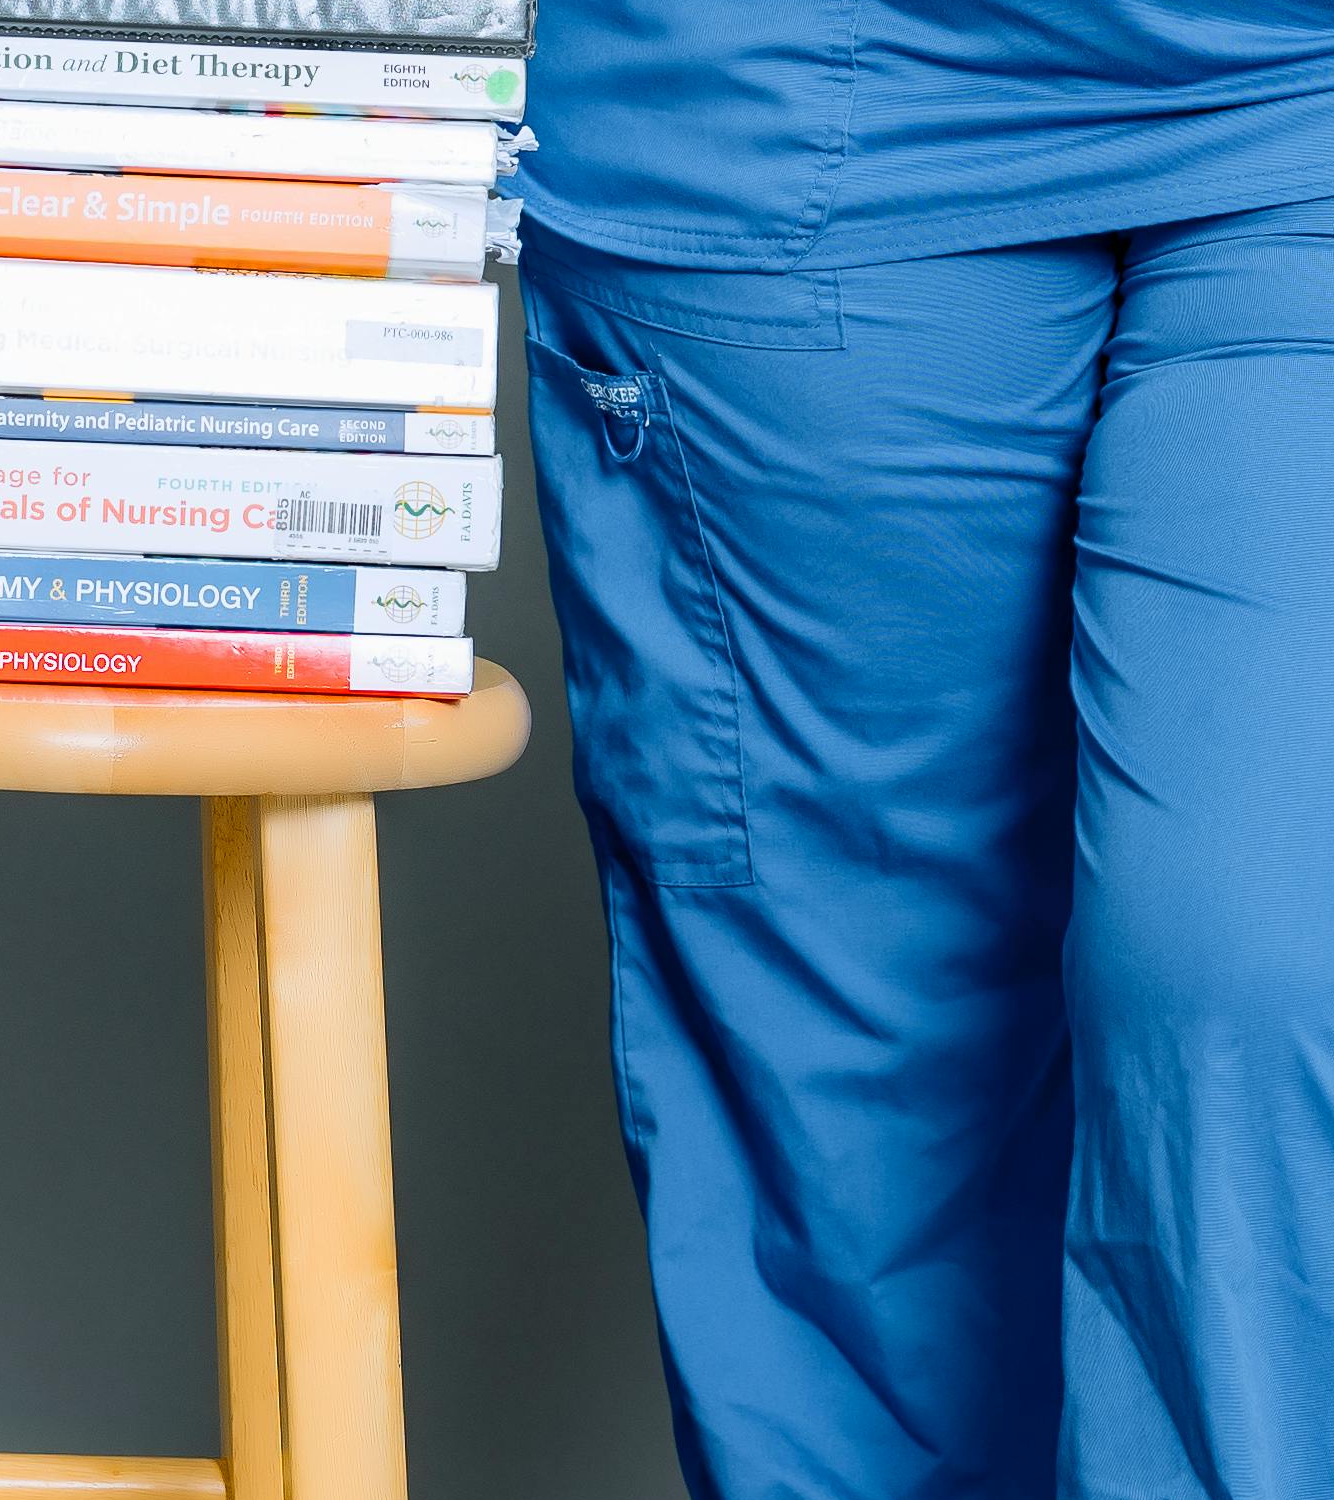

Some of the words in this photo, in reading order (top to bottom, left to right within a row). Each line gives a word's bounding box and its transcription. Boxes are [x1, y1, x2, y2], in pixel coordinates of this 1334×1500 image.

[62, 55, 108, 73] and
[113, 50, 183, 76] Diet
[191, 53, 320, 87] Therapy
[383, 63, 427, 75] EIGHTH
[383, 77, 430, 89] EDITION
[83, 191, 108, 220] &
[116, 192, 231, 232] Simple
[240, 208, 304, 226] FOURTH
[309, 211, 374, 229] EDITION
[382, 326, 454, 342] PTC-000-986
[74, 412, 110, 430] and
[113, 412, 196, 434] Pediatric
[200, 416, 273, 440] Nursing
[277, 419, 320, 438] Care
[339, 419, 387, 431] SECOND
[339, 433, 387, 444] EDITION
[53, 466, 91, 486] for
[158, 477, 233, 492] FOURTH
[241, 480, 285, 494] EDIT
[299, 490, 311, 499] AC
[462, 482, 473, 520] DAVIS
[56, 496, 92, 522] of
[102, 498, 231, 533] Nursing
[242, 502, 276, 530] Ca
[276, 498, 289, 531] 855
[49, 578, 67, 600] &
[76, 579, 261, 610] PHYSIOLOGY
[279, 579, 292, 618] THIRD
[296, 574, 308, 625] EDITION
[430, 585, 439, 610] DAVIS
[273, 646, 283, 675] THIRD
[286, 646, 295, 680] EDITION
